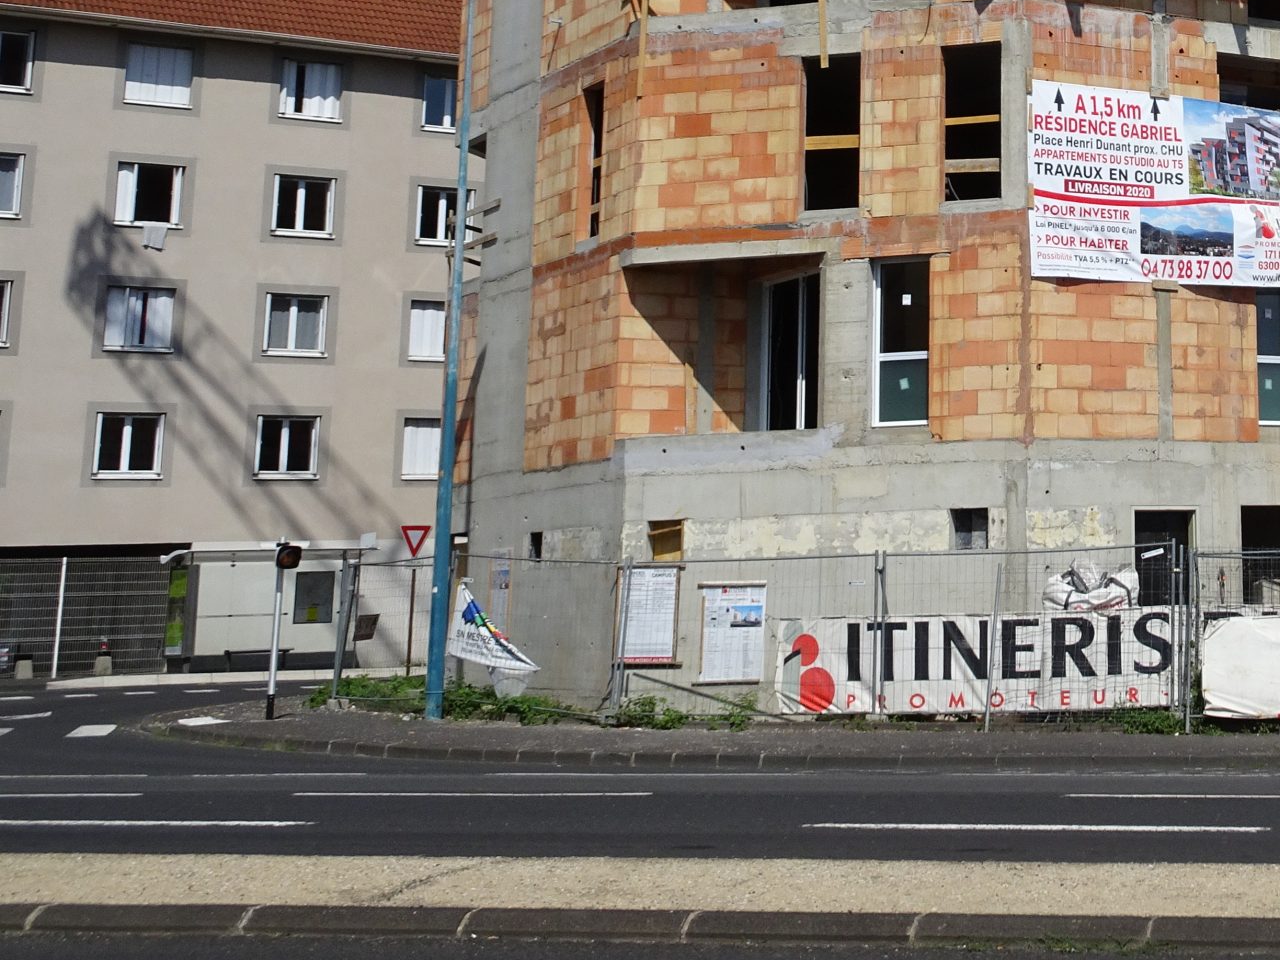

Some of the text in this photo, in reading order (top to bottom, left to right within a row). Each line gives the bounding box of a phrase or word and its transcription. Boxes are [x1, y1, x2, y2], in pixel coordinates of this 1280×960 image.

[1075, 94, 1141, 121] A 1,5 km
[1034, 111, 1182, 142] RÉSIDENCE GABRIEL
[1034, 133, 1183, 156] Place Henri Dunant prox. CHU
[1034, 148, 1184, 169] APPARTEMENTS DU STUDIO AU T5
[1034, 162, 1184, 185] TRAVAUX EN COURS
[1068, 181, 1151, 198] LIVRAISON 2020
[1043, 204, 1130, 220] POUR INVESTIR
[1121, 226, 1137, 235] €/an
[1045, 234, 1128, 250] POUR HABITER
[1074, 254, 1088, 262] TVA
[1089, 256, 1100, 264] 5,5
[1265, 250, 1277, 259] 171
[1141, 258, 1159, 278] 04
[1161, 259, 1174, 278] 73
[1177, 259, 1193, 279] 28
[1196, 260, 1210, 279] 37
[1212, 260, 1233, 280] 00
[846, 611, 1172, 681] ITINERIS
[846, 687, 1139, 709] PROMOTEUR
